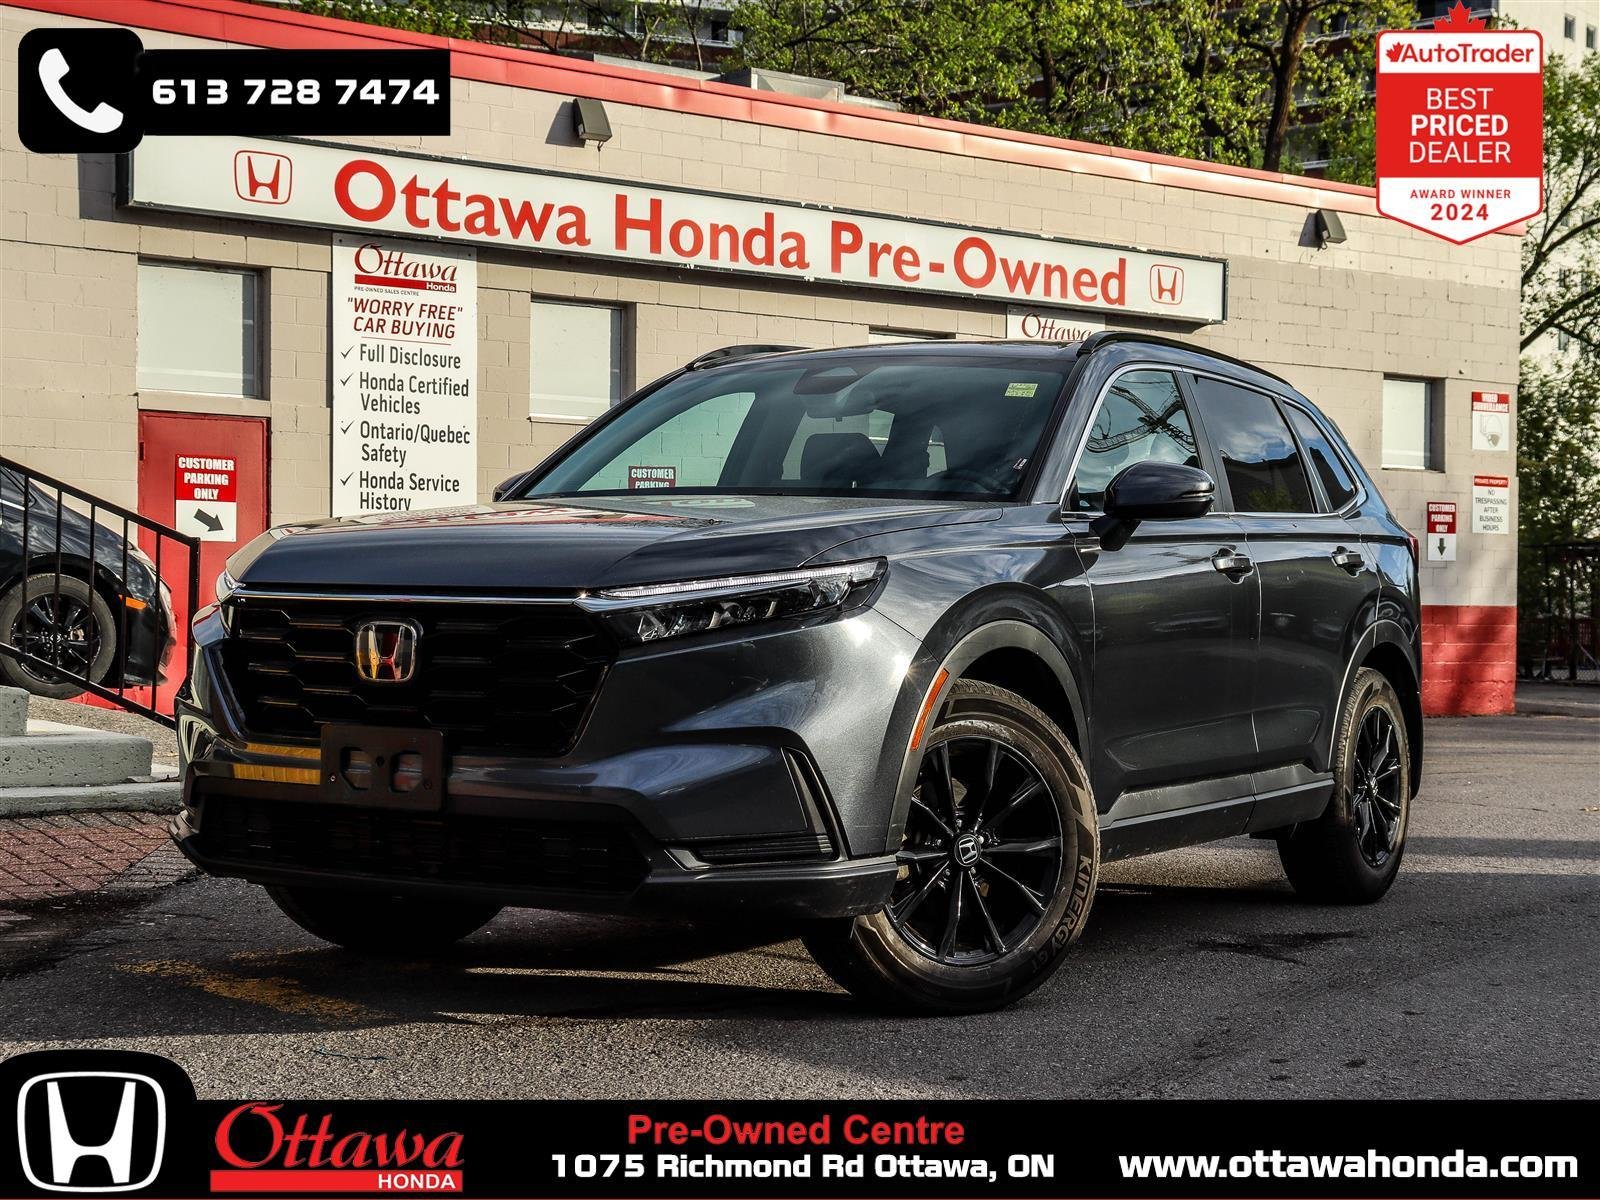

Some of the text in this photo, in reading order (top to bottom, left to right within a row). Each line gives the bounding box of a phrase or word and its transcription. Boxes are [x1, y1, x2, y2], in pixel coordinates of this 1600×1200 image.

[334, 159, 1127, 306] Ottawa Honda Pre-Owned
[354, 243, 458, 282] Ottawa
[354, 286, 384, 294] PRE-OWNED
[425, 282, 456, 293] Honda
[353, 316, 456, 339] CAR BUYING
[360, 344, 461, 369] Full Disclosure
[360, 371, 469, 397] Honda Certified
[361, 393, 421, 415] Vehicles
[361, 443, 407, 468] Safety
[178, 456, 235, 471] CUSTOMER
[183, 472, 229, 486] PARKING
[631, 468, 674, 479] CUSTOMER
[360, 470, 460, 493] Honda Service
[193, 487, 219, 500] ONLY
[360, 491, 411, 511] History
[1428, 503, 1456, 512] CUSTOMER
[1475, 497, 1507, 505] TRESPASSING
[1483, 506, 1499, 514] AFTER
[1431, 514, 1453, 522] PARKING
[1479, 515, 1503, 523] BUSINESS
[1435, 524, 1448, 532] ONLY
[1482, 524, 1500, 532] HOURS
